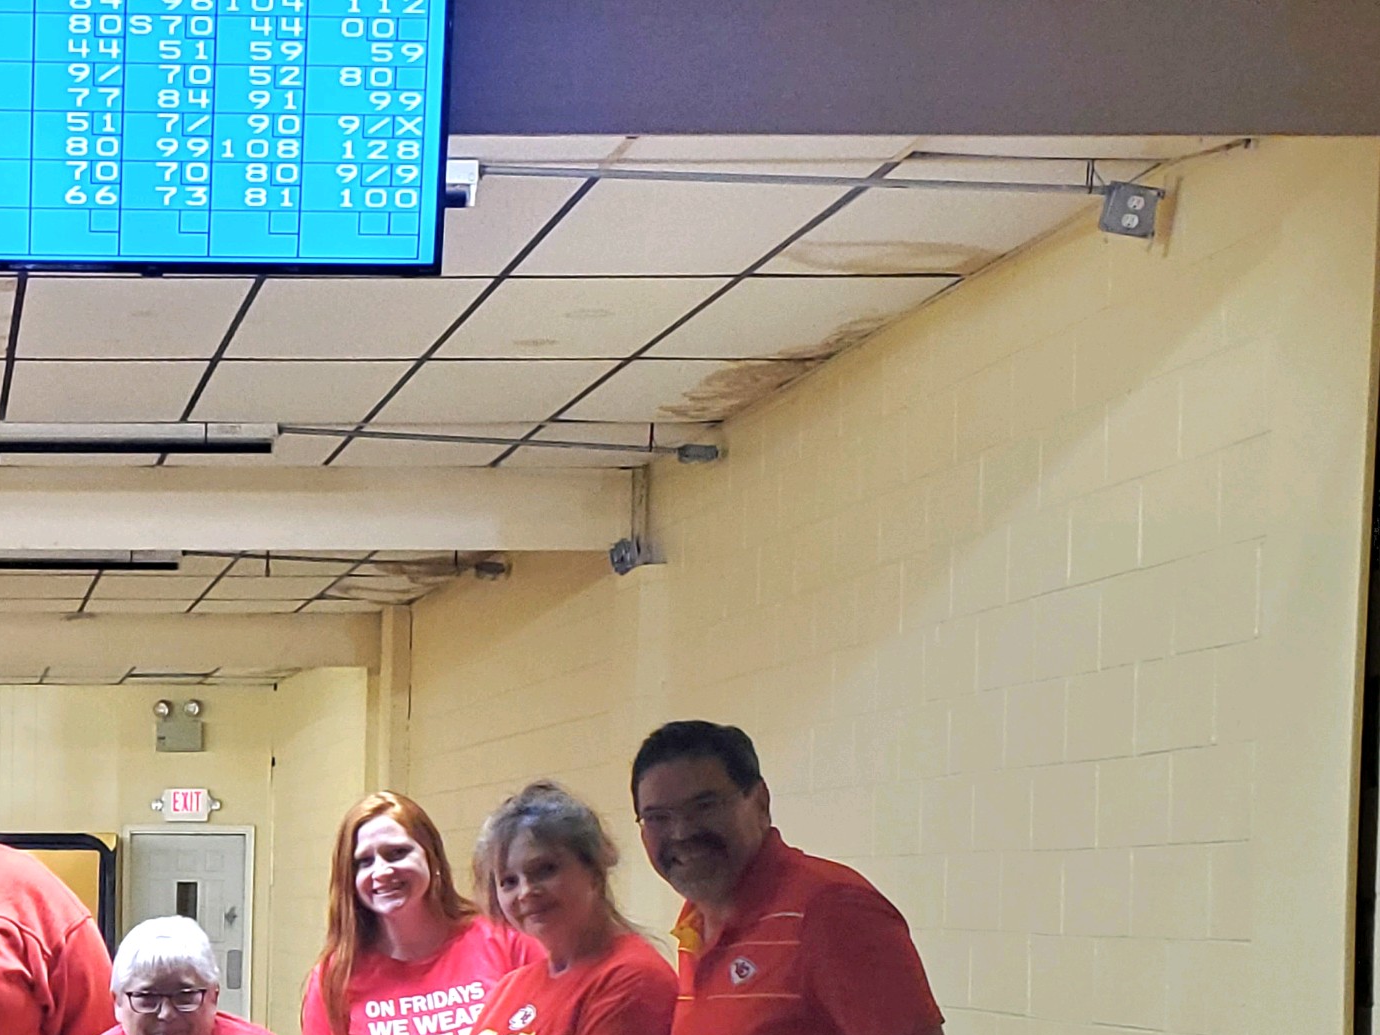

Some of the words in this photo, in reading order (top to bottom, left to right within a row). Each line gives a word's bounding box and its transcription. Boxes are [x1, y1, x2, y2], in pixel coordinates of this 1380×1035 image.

[68, 14, 122, 34] 80
[129, 15, 213, 35] S70
[250, 17, 303, 36] 44
[341, 18, 395, 37] 00
[68, 39, 121, 58] 44
[159, 40, 208, 59] 51
[249, 42, 304, 60] 59
[371, 43, 425, 62] 59
[67, 64, 121, 82] 9/
[159, 65, 212, 84] 70
[249, 66, 301, 85] 52
[339, 67, 393, 86] 80
[67, 88, 121, 106] 77
[157, 89, 210, 108] 84
[248, 91, 297, 109] 91
[369, 92, 423, 110] 99
[66, 112, 115, 132] 51
[157, 113, 210, 132] 7/
[247, 115, 301, 134] 90
[337, 116, 423, 135] 9/X
[65, 137, 119, 156] 80
[156, 138, 210, 157] 99
[221, 139, 300, 158] 108
[342, 140, 420, 159] 128
[65, 161, 119, 180] 70
[155, 162, 209, 181] 70
[245, 163, 299, 182] 80
[335, 164, 419, 183] 9/9
[64, 186, 118, 204] 66
[155, 187, 208, 205] 73
[244, 188, 293, 206] 81
[340, 189, 418, 208] 100
[172, 791, 202, 812] EXIT
[365, 1000, 396, 1018] ON
[398, 982, 485, 1013] FRIDAYS
